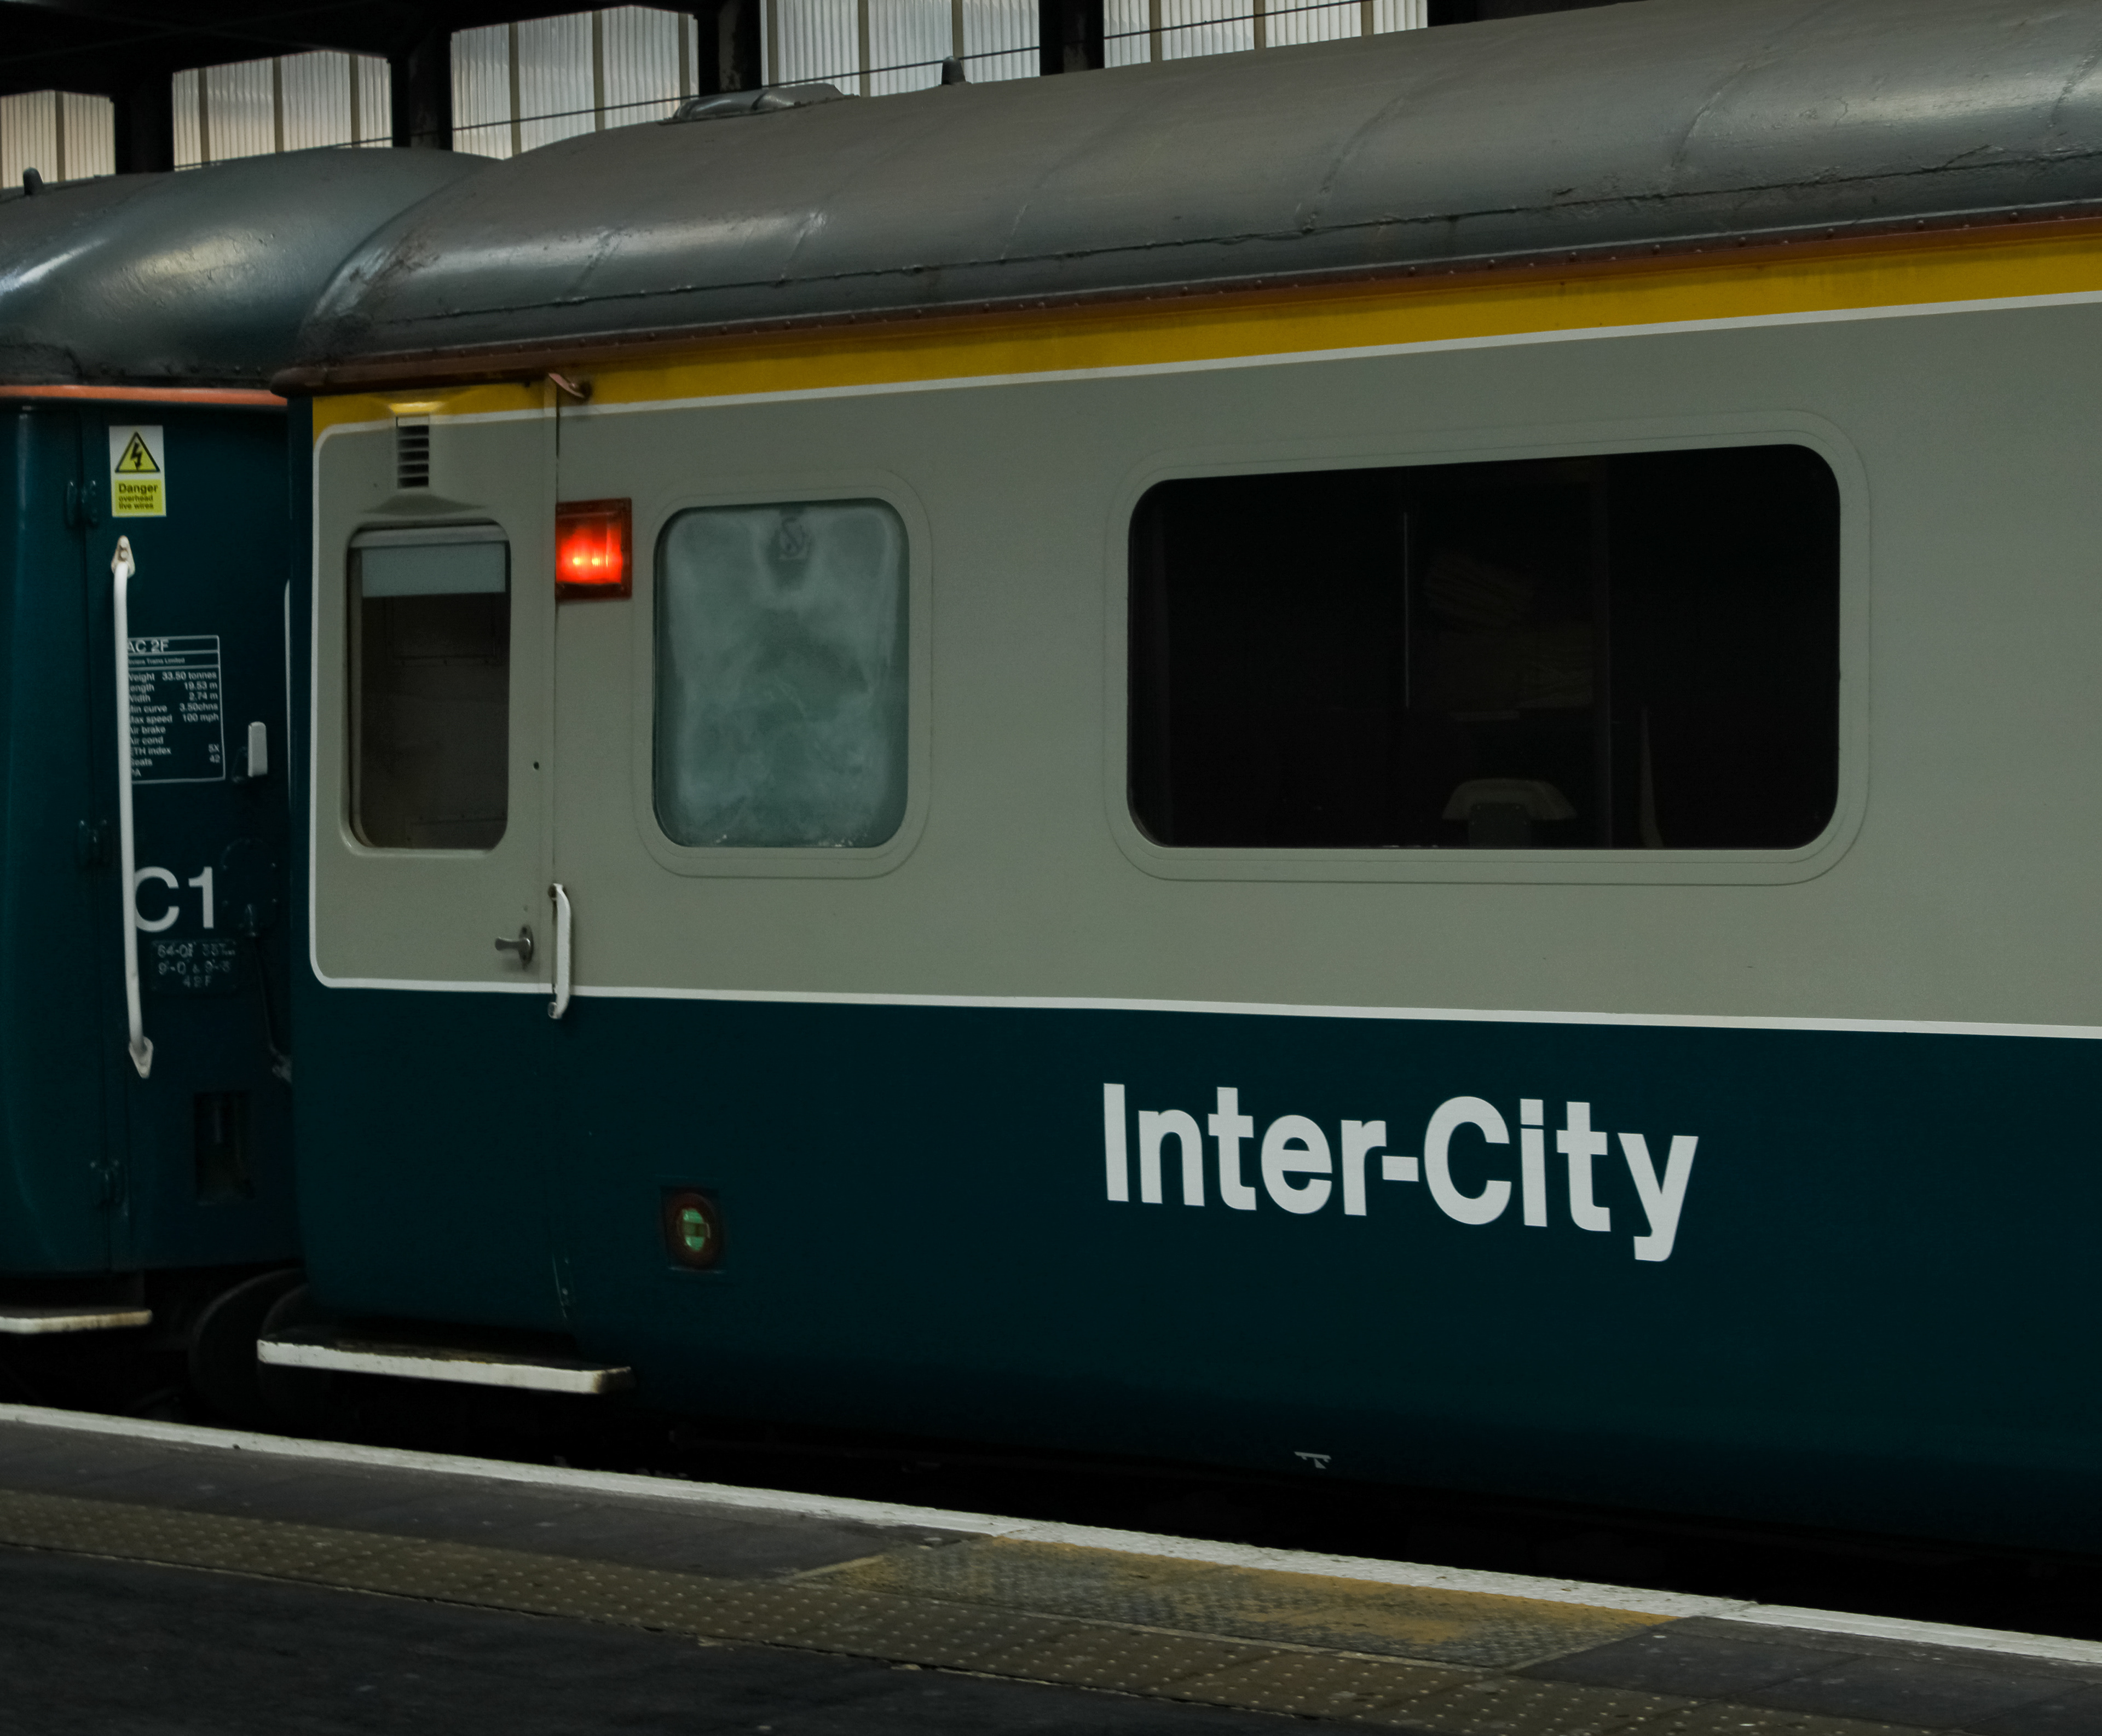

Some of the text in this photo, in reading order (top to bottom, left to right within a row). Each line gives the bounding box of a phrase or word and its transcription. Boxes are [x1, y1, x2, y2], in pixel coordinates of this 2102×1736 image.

[119, 483, 158, 495] Danger
[151, 639, 169, 653] 2F
[162, 671, 186, 681] 33.50
[188, 672, 217, 680] tonnes
[129, 683, 155, 694] ength
[184, 681, 207, 691] 19.53
[189, 692, 207, 701] 2.74
[143, 705, 168, 713] curve
[146, 714, 173, 725] speed
[182, 713, 198, 722] 100
[200, 713, 219, 723] mph
[141, 725, 166, 734] brake
[142, 736, 164, 745] cond
[148, 746, 172, 755] index
[135, 866, 214, 933] C1
[1103, 1083, 1699, 1262] Inter-City
